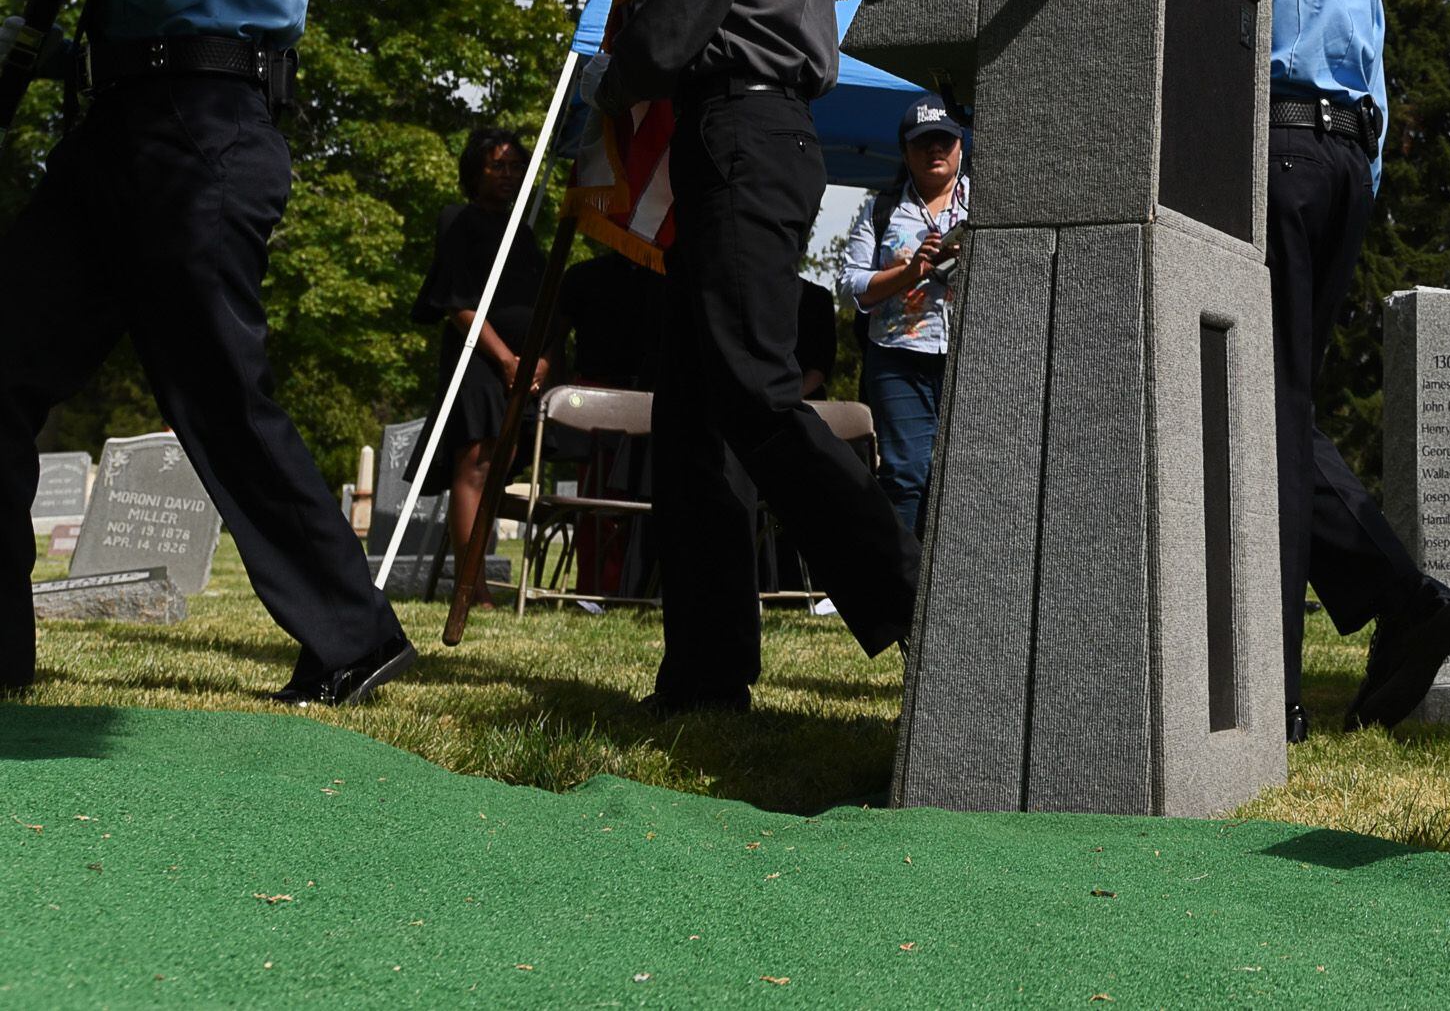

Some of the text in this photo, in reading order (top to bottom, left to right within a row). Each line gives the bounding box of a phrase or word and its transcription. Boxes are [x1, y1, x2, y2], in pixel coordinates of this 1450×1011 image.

[1422, 379, 1450, 390] James
[1422, 401, 1444, 413] John
[1421, 423, 1450, 436] Henry
[108, 490, 206, 512] MORONI DAVID
[127, 508, 178, 524] MILLER
[162, 528, 191, 541] 1878
[103, 536, 132, 548] APR.
[157, 542, 187, 554] 1926
